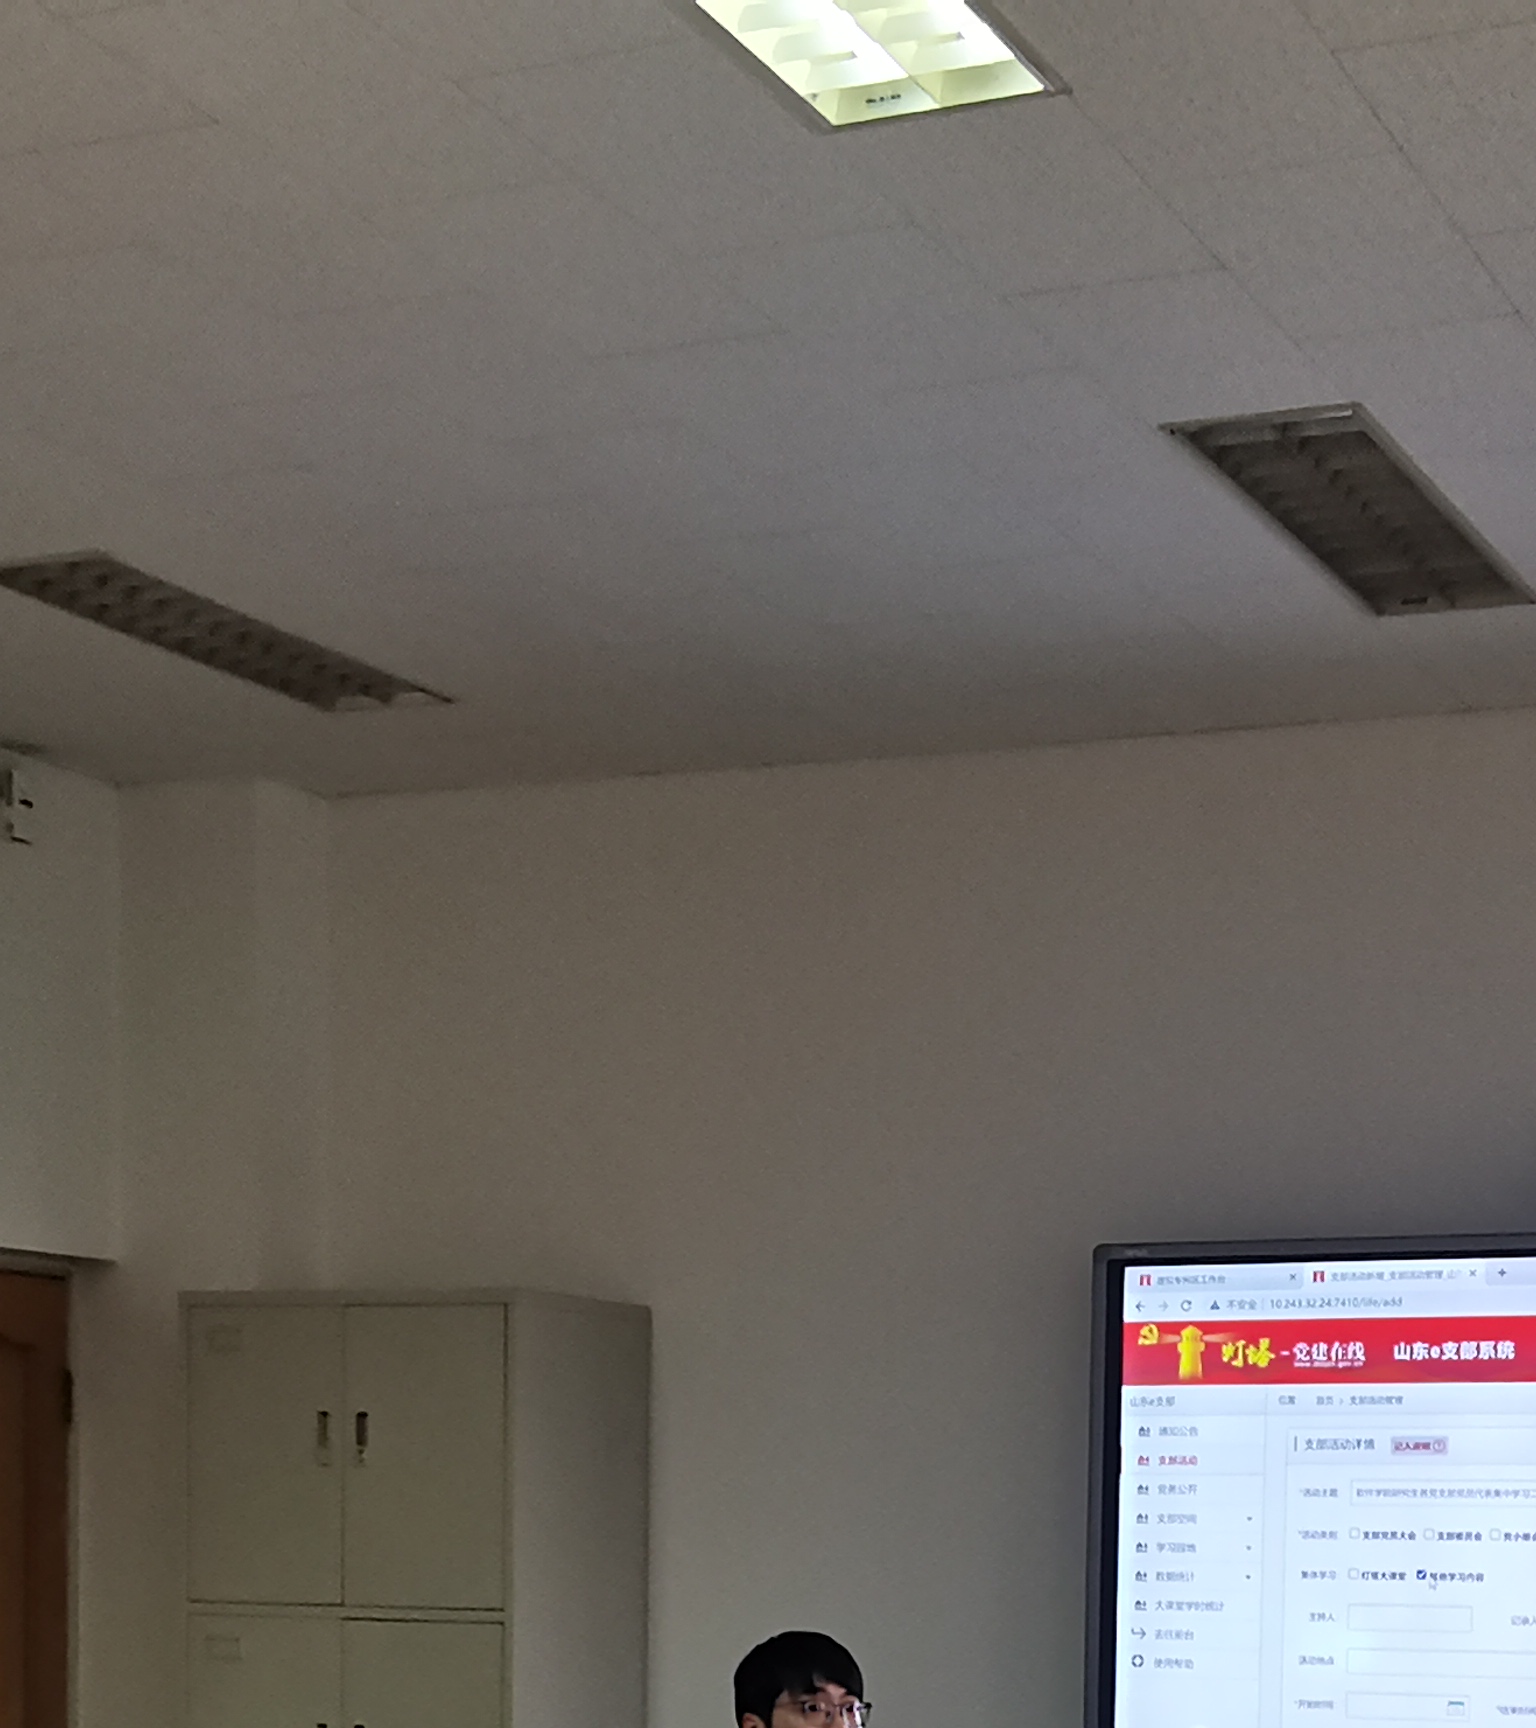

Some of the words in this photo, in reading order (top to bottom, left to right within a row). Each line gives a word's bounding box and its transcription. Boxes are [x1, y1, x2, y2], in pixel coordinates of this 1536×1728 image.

[1393, 1340, 1517, 1361] 山东e支部系统
